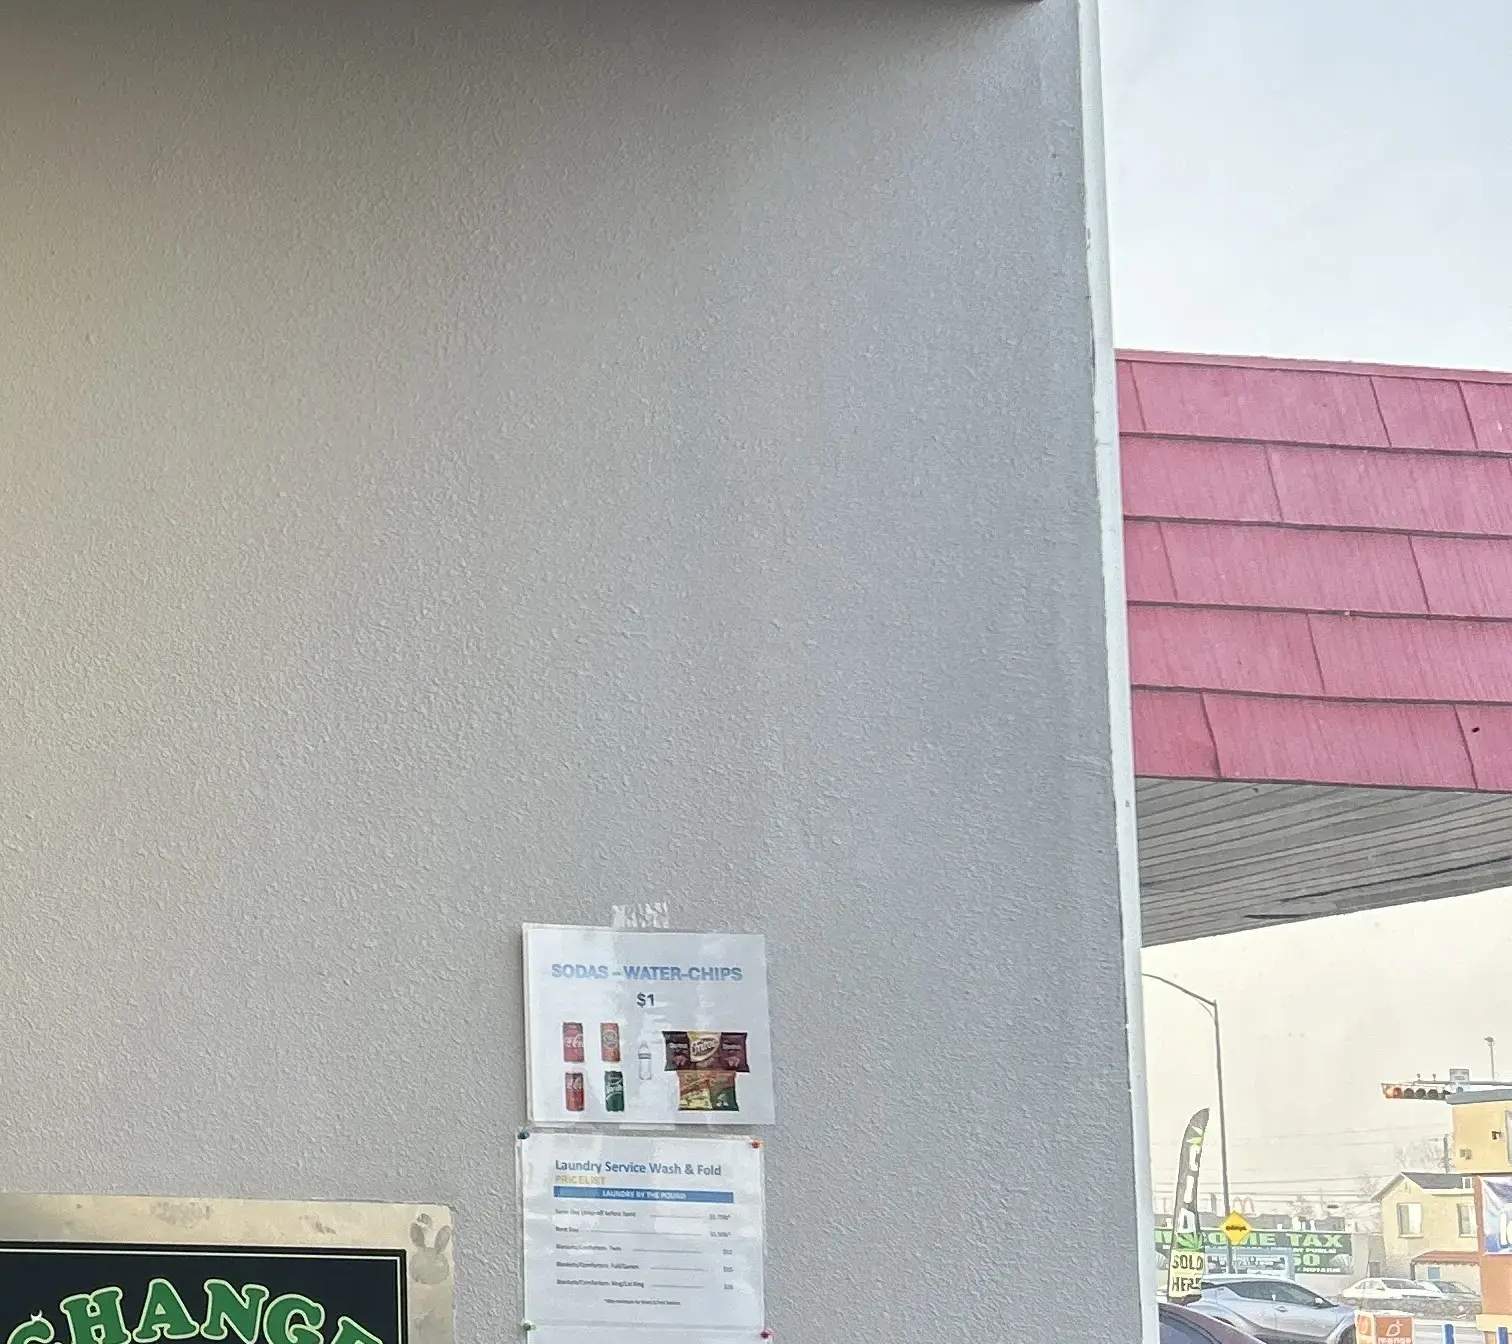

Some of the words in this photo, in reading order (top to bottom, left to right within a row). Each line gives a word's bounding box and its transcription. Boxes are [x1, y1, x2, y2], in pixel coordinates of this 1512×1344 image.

[551, 964, 609, 979] SODAS
[637, 992, 655, 1008] $1
[555, 1160, 602, 1174] Laundry
[605, 1161, 646, 1174] Service
[649, 1163, 682, 1175] Wash
[684, 1164, 694, 1175] &
[697, 1165, 721, 1176] Fold
[1285, 1233, 1343, 1247] TAX
[1172, 1254, 1203, 1270] SOLD
